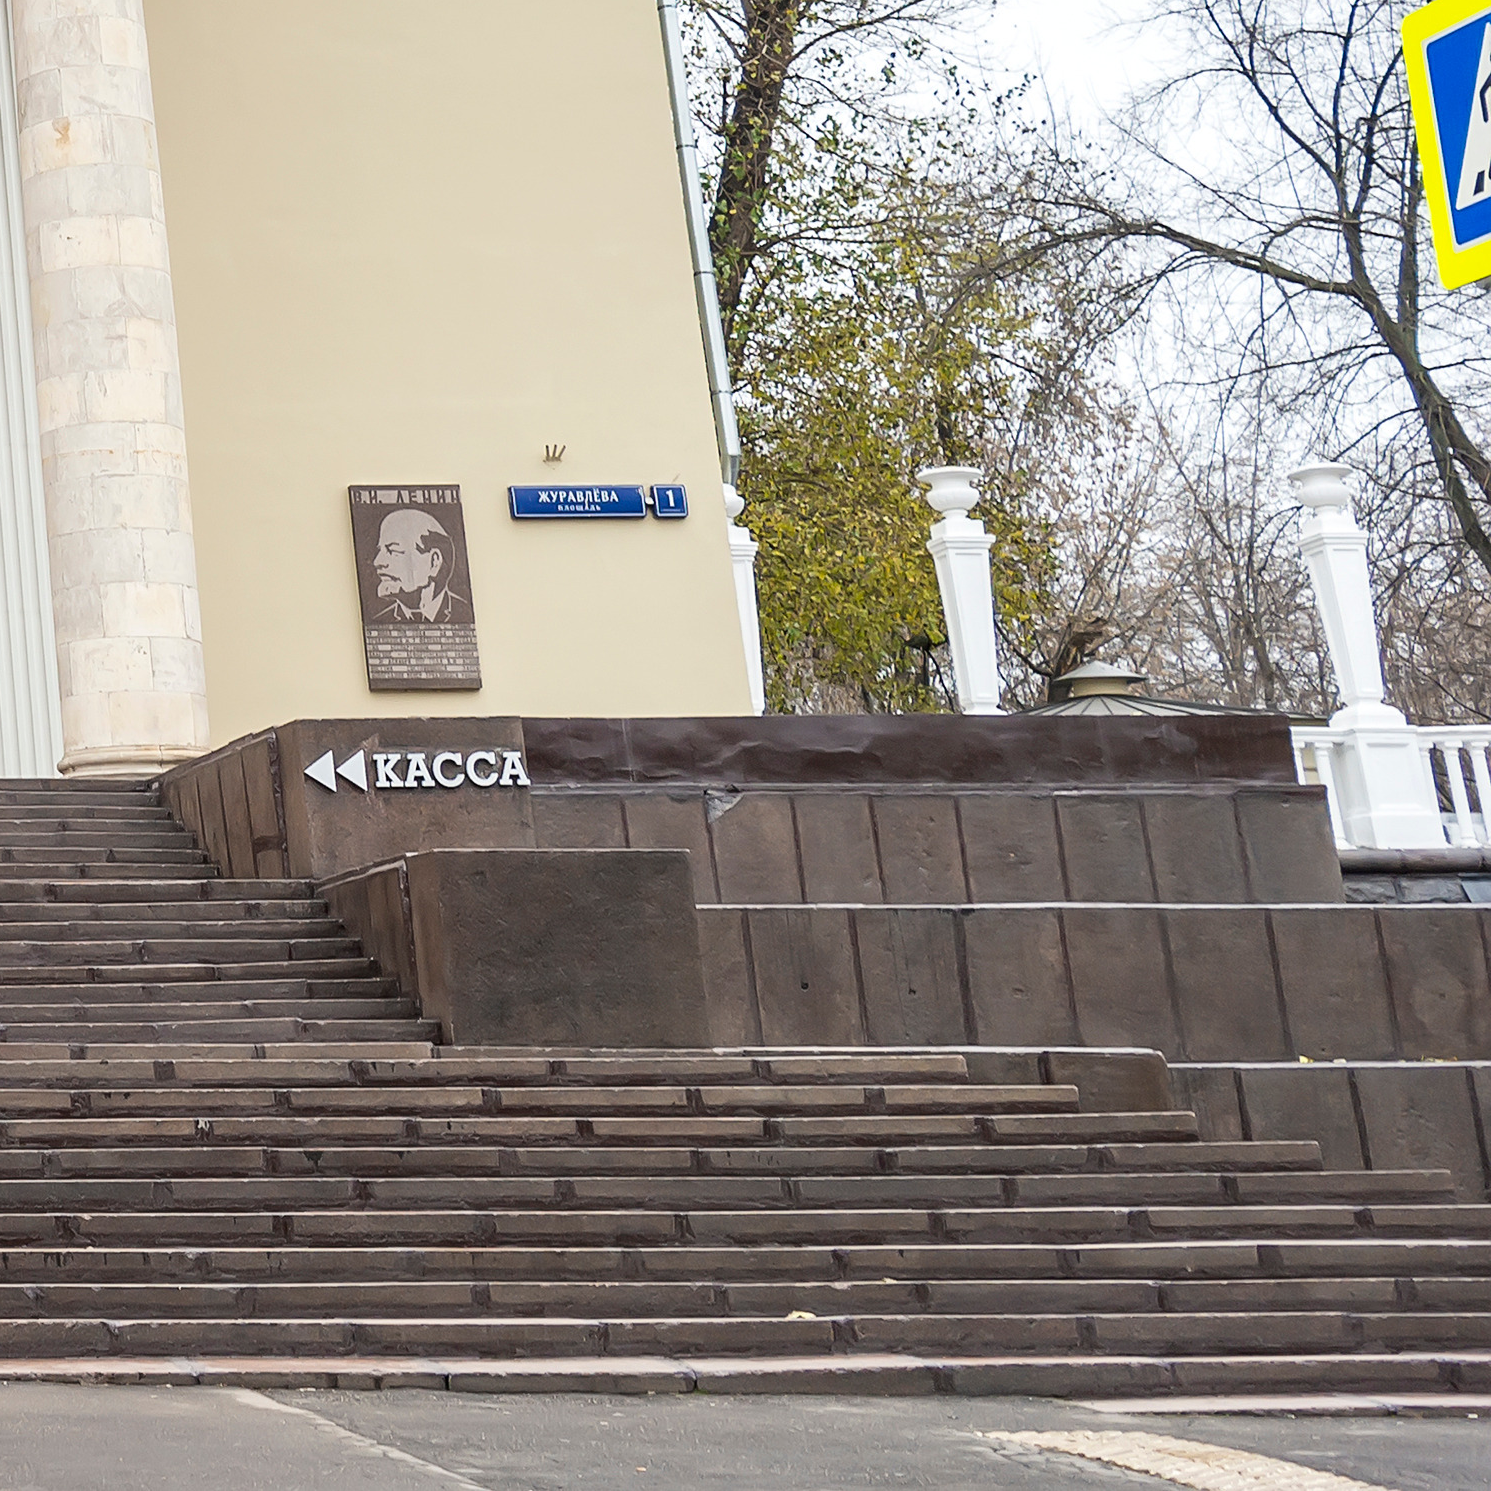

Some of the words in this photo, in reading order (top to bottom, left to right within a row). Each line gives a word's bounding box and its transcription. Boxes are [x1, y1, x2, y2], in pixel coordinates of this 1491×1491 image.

[396, 490, 460, 504] ЛЕНИН
[538, 488, 619, 504] ЖУРАВЛЁВА
[665, 490, 676, 508] 1
[372, 750, 532, 789] КАССА
